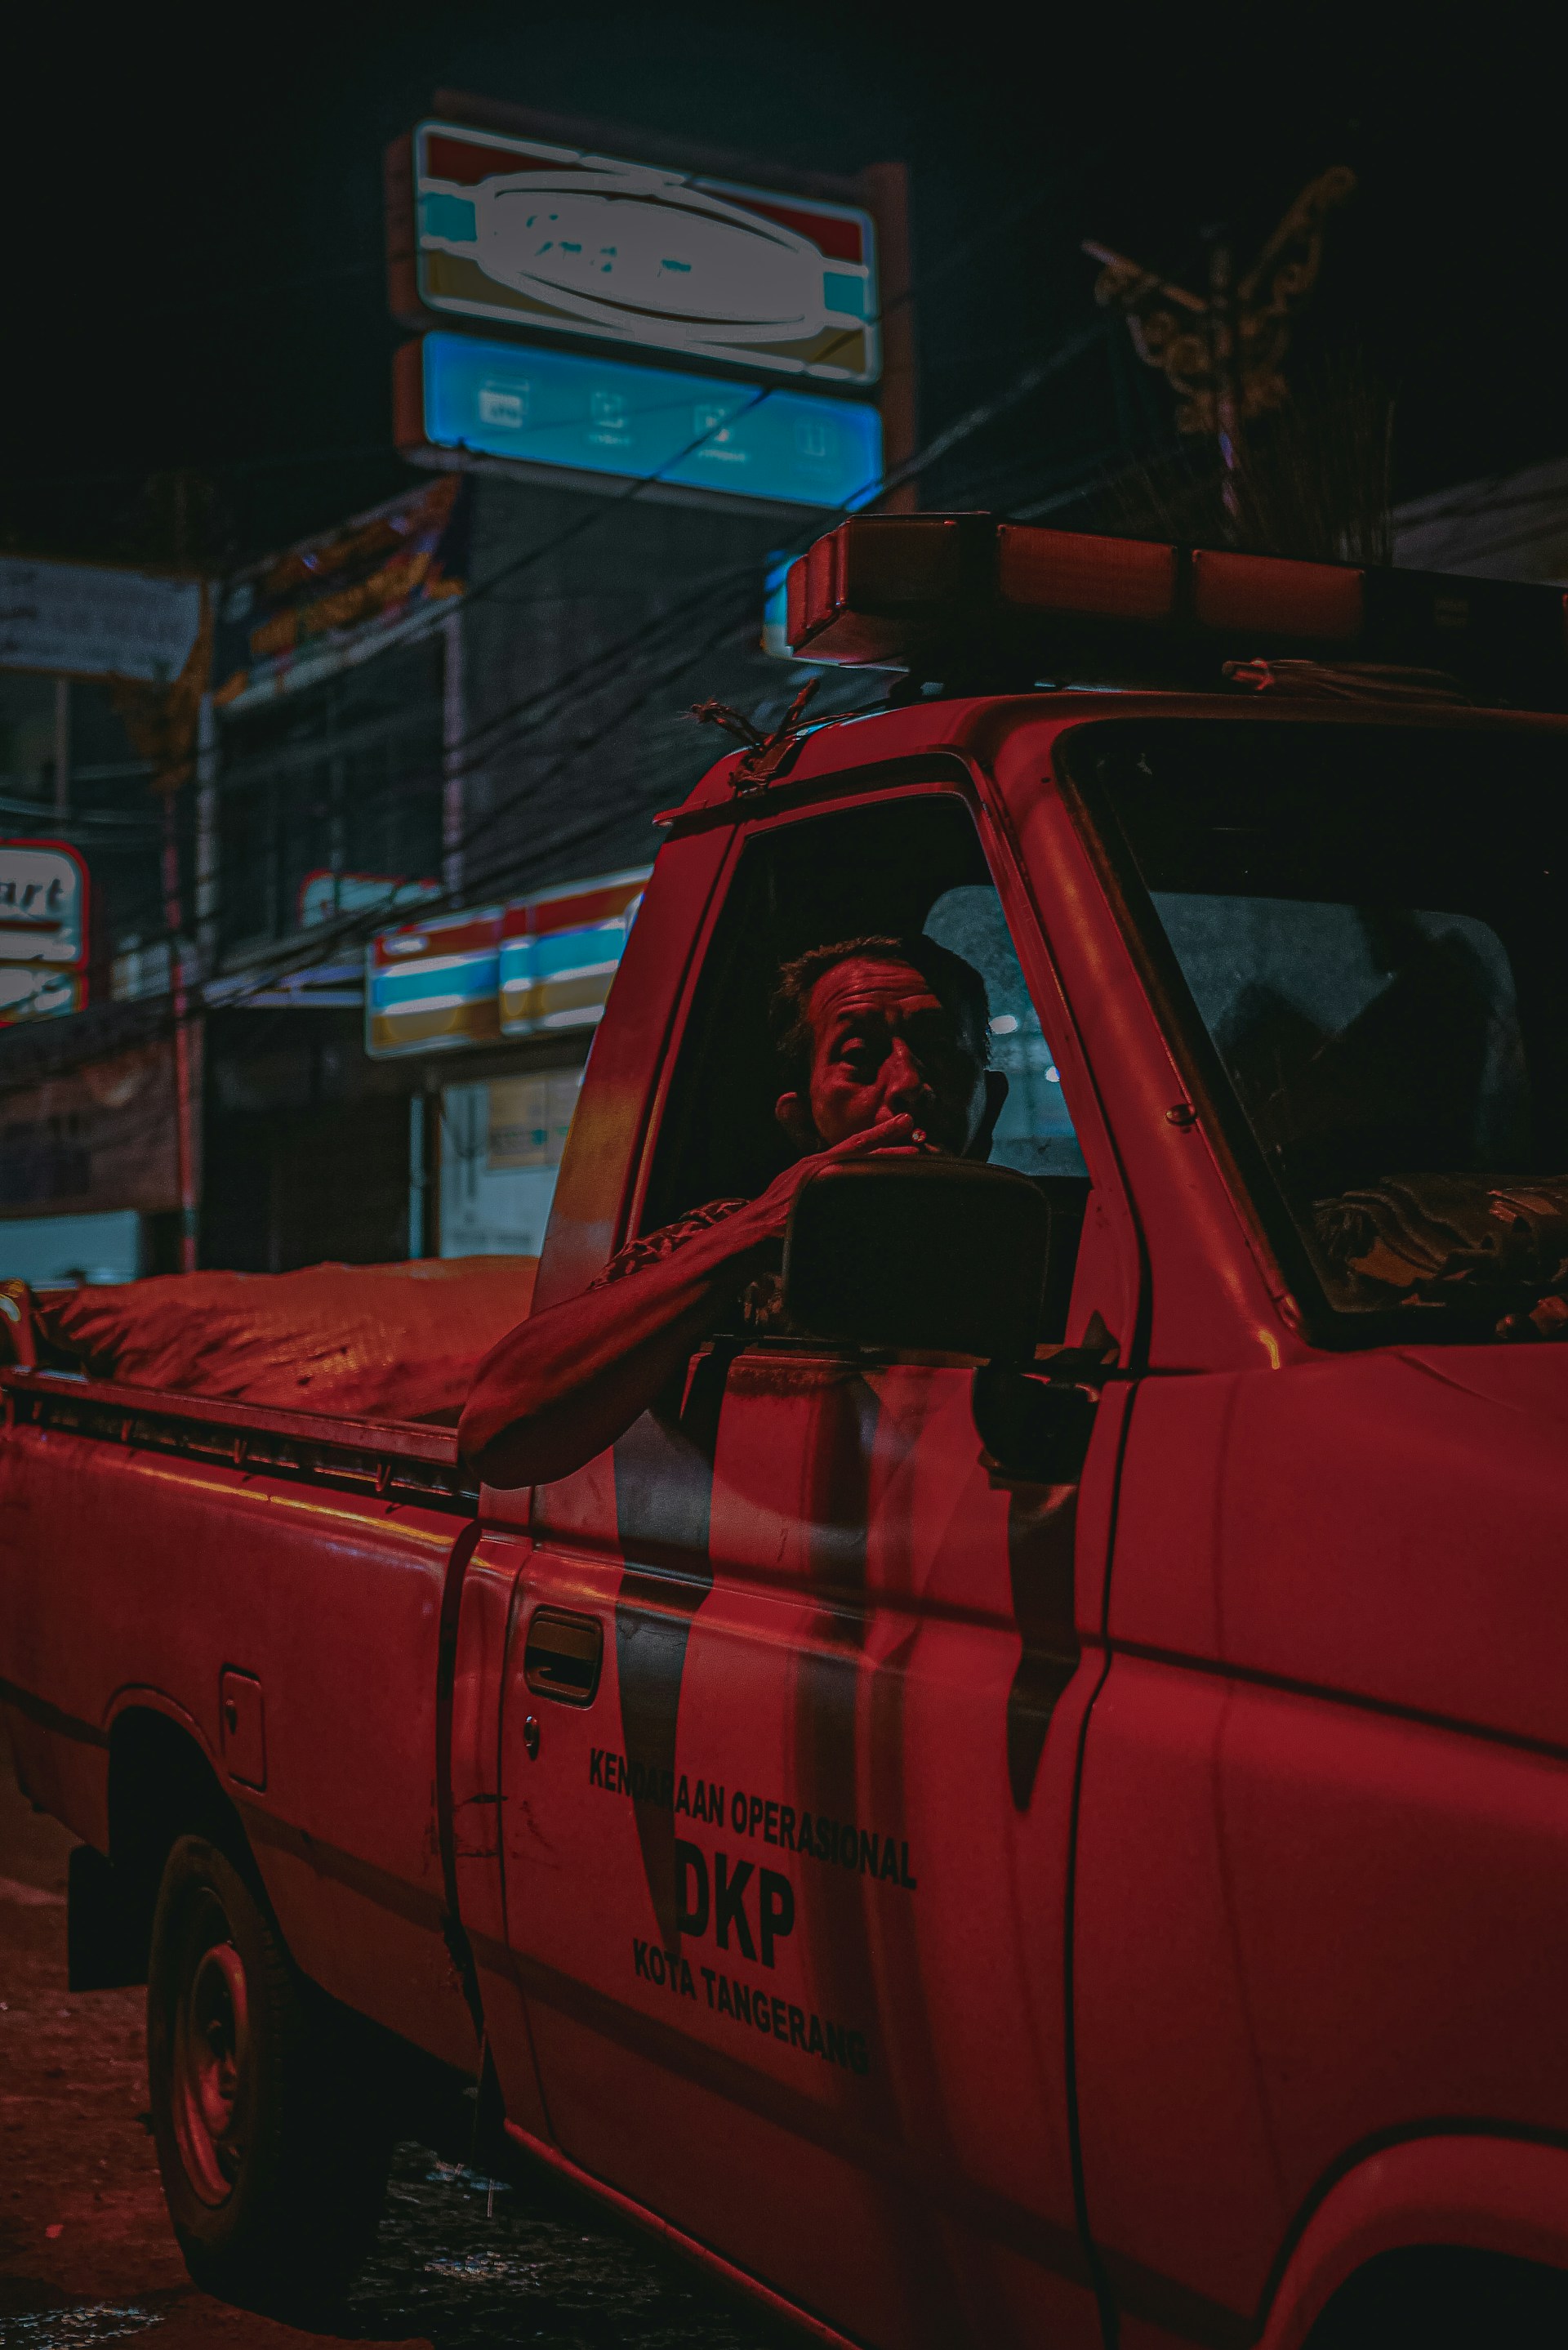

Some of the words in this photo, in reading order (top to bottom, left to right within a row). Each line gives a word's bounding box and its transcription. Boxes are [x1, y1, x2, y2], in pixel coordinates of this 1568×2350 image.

[590, 1747, 724, 1827] KENDARAAN
[731, 1792, 917, 1890] OPERASIONAL
[675, 1837, 795, 1969] DKP
[633, 1938, 697, 2000] KOTA
[701, 1967, 869, 2076] TANGERANG
